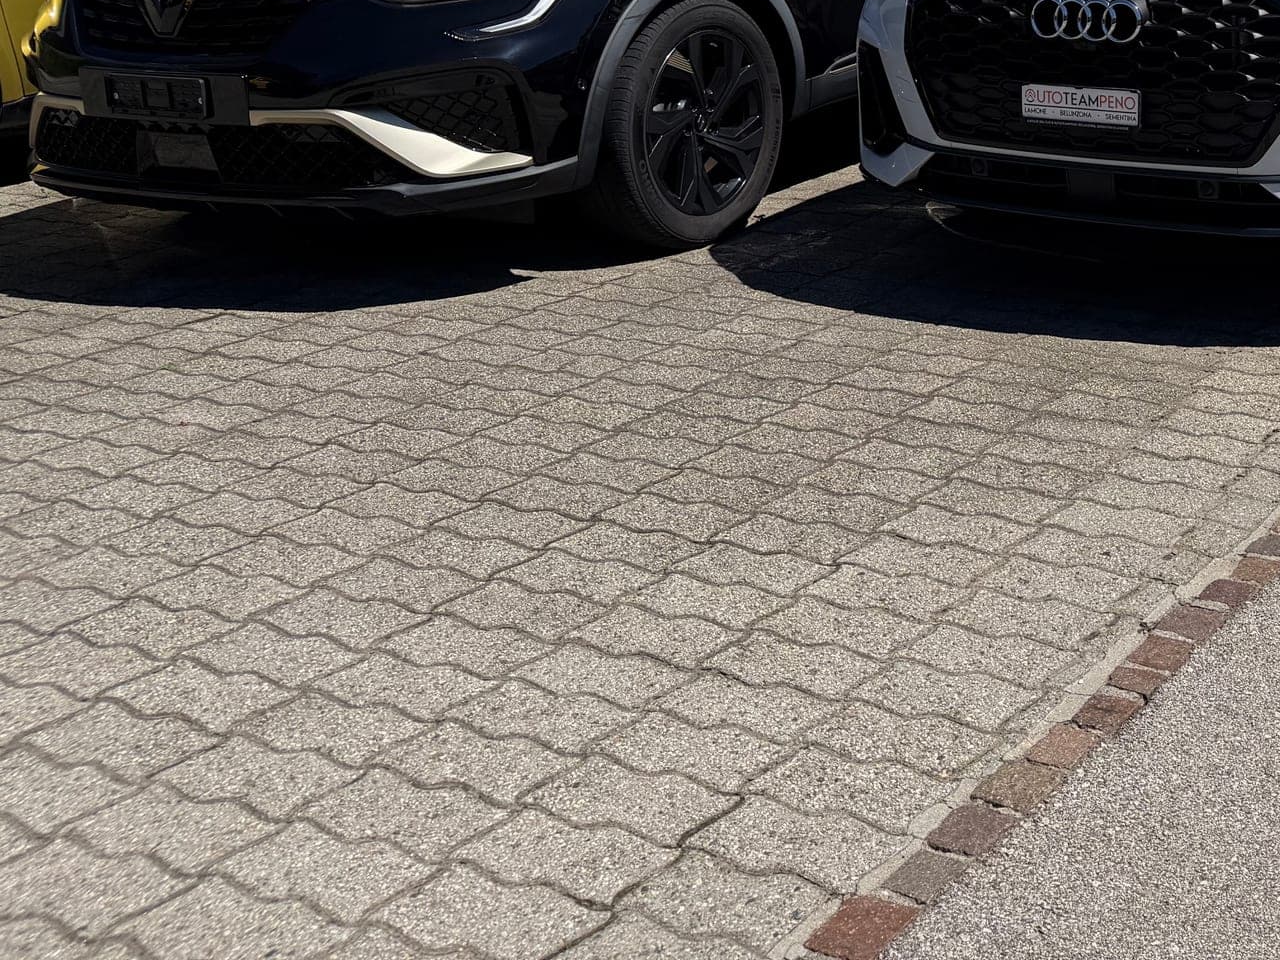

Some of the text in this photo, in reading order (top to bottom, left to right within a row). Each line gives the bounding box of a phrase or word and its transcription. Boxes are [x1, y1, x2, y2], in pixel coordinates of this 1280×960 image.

[1024, 107, 1137, 122] LAMONE BELLINZONA SEMENTINA
